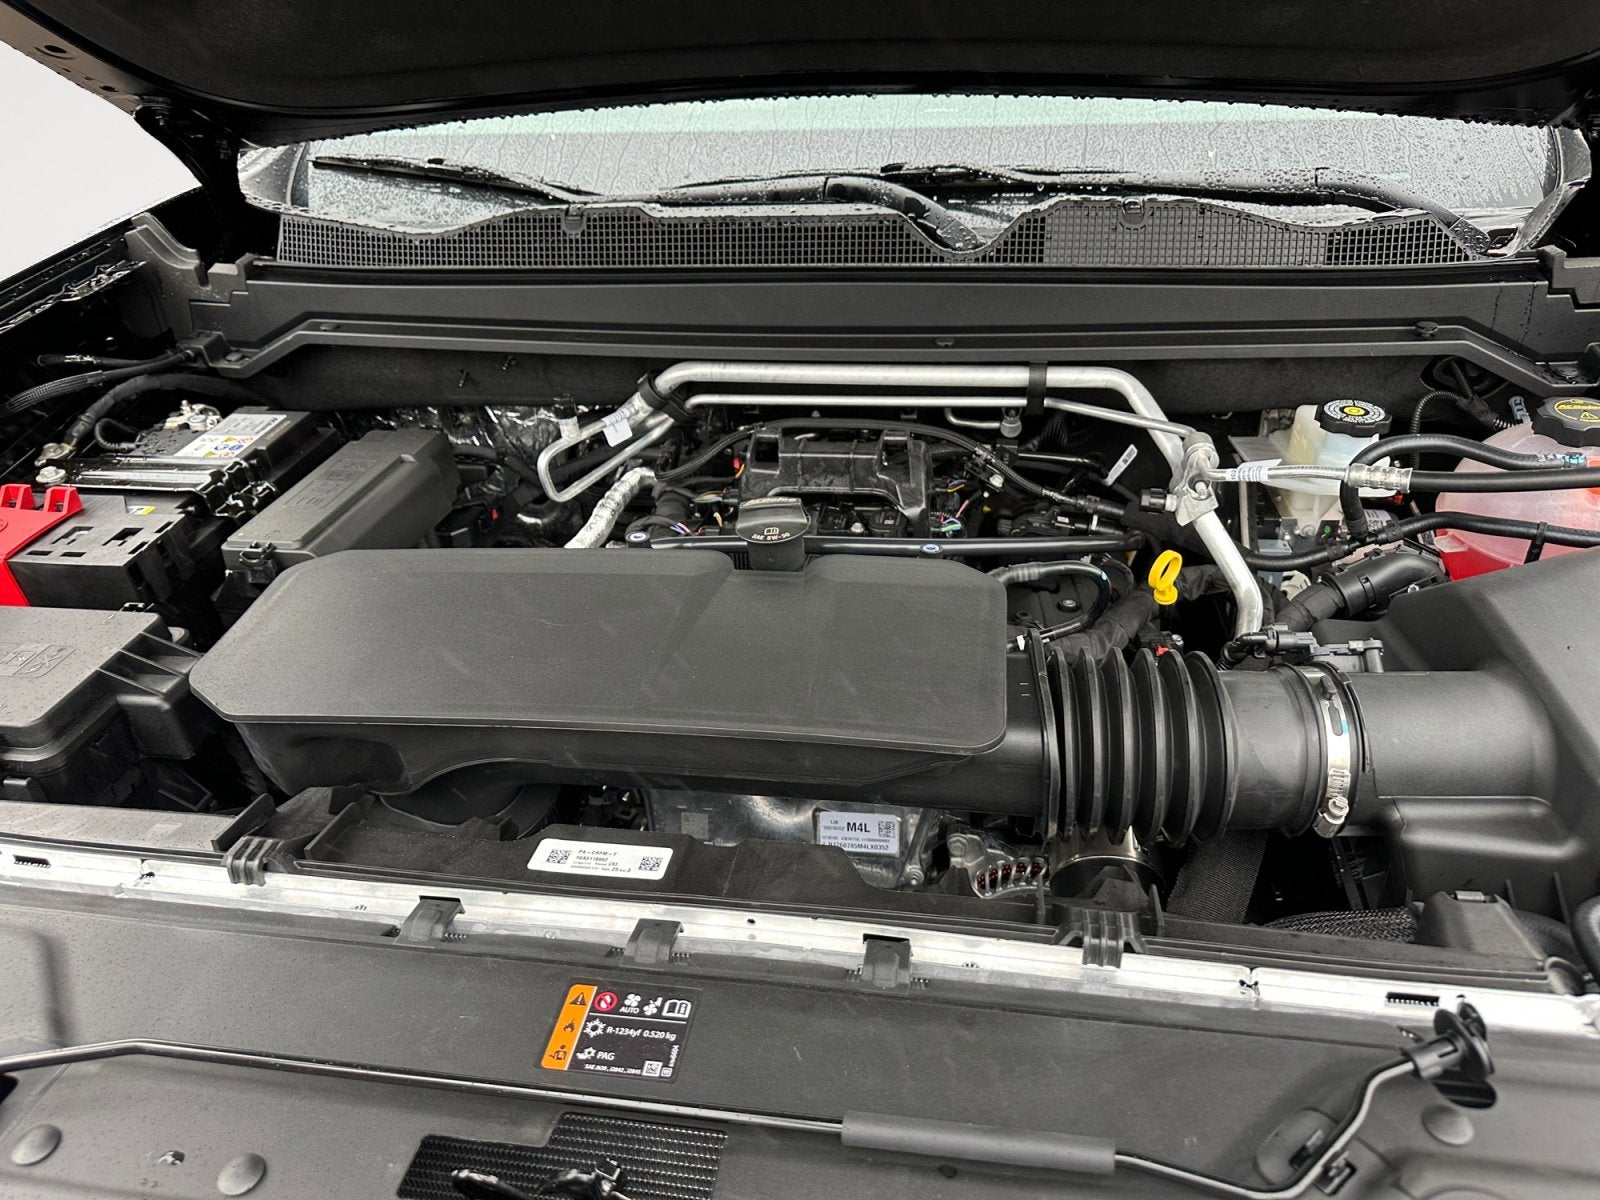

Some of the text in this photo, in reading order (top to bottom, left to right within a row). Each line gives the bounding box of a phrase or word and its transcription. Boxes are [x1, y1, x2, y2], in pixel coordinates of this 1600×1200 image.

[846, 821, 871, 833] M4L
[619, 1006, 640, 1014] AUTO
[606, 1026, 677, 1041] R-1234yf 0.520 kg
[596, 1051, 616, 1061] PAG
